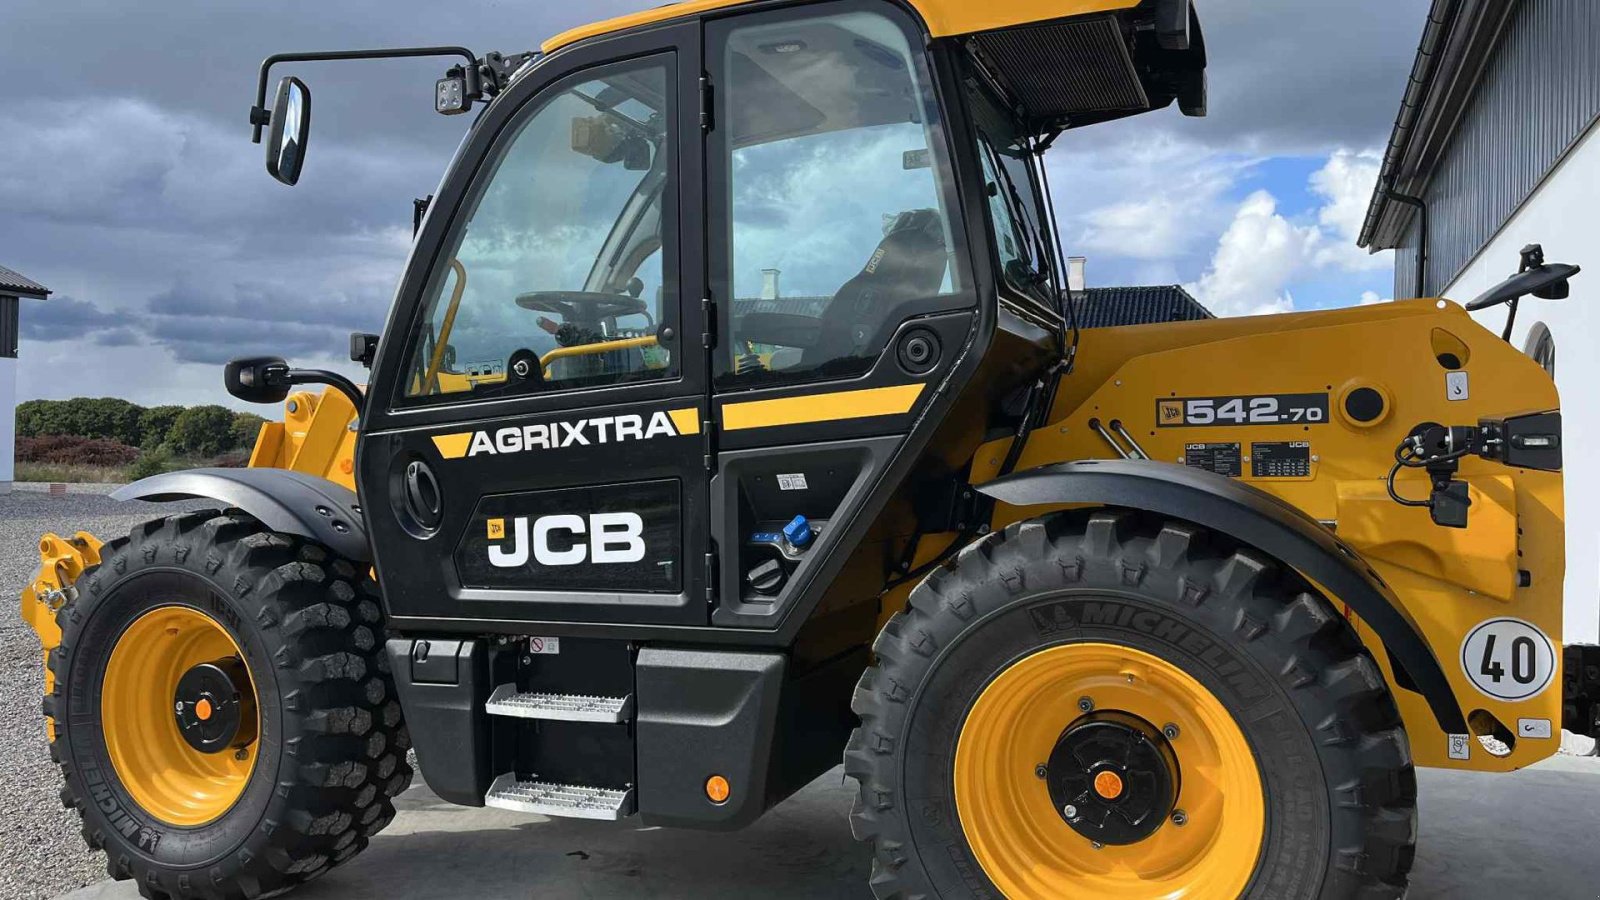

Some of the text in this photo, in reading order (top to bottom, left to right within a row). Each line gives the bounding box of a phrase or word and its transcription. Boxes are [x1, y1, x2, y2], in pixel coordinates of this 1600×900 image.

[468, 411, 677, 457] AGRIXTRA
[1187, 398, 1322, 424] 542-70
[487, 512, 646, 567] JCB
[1081, 602, 1269, 702] MICHELIN
[1480, 634, 1536, 685] 40
